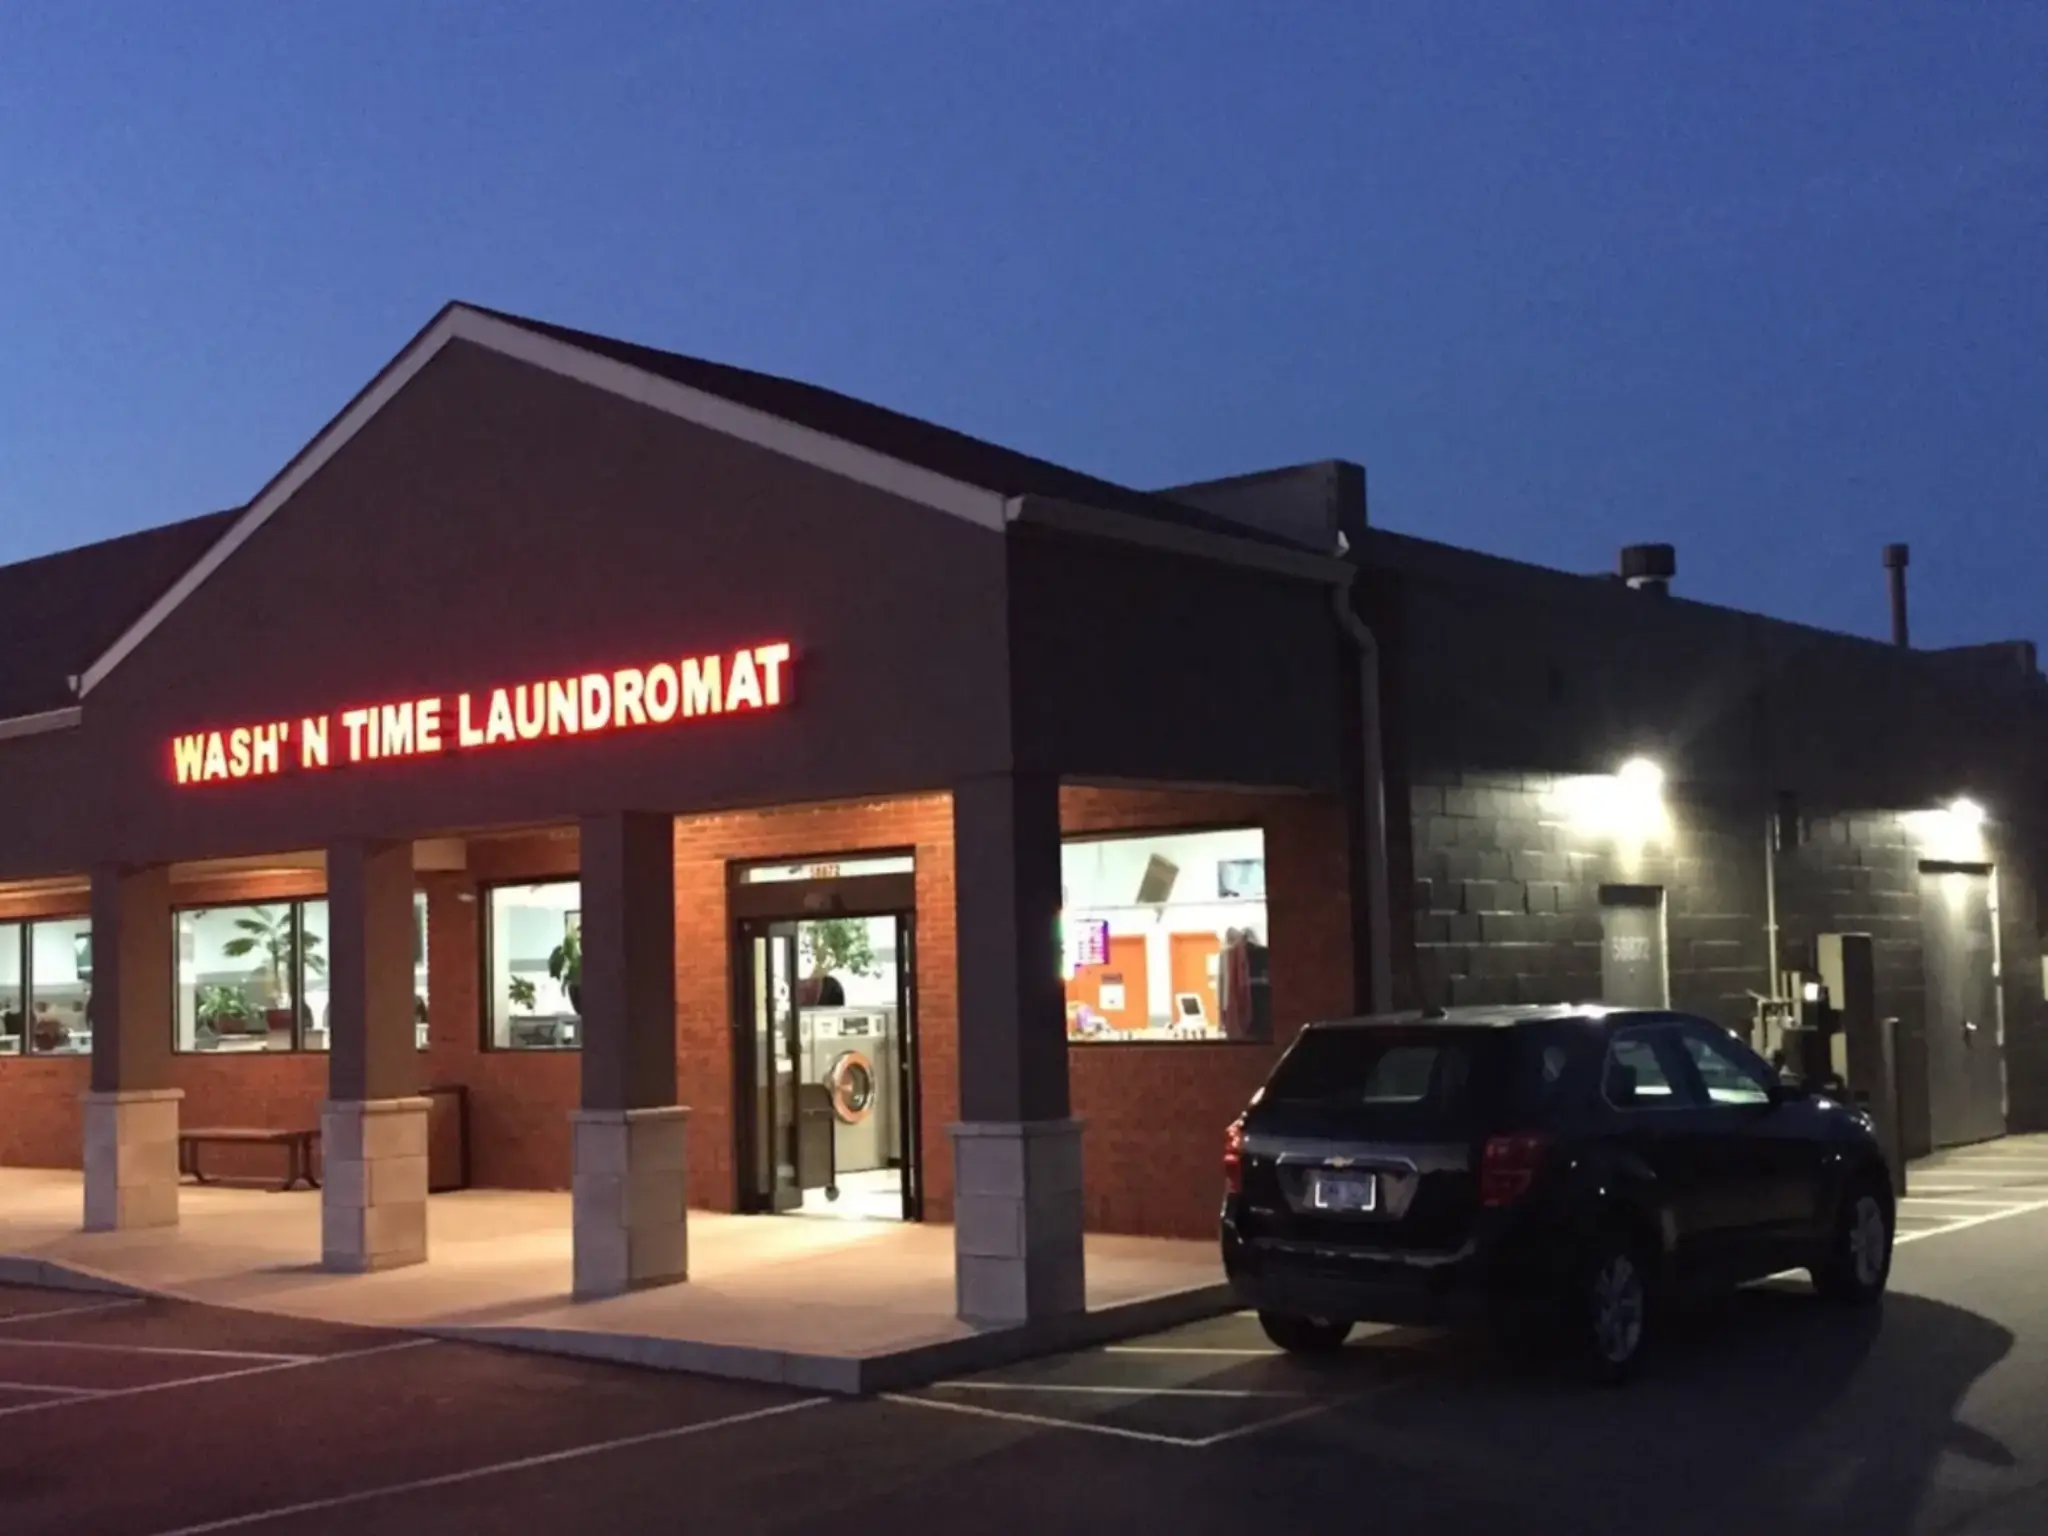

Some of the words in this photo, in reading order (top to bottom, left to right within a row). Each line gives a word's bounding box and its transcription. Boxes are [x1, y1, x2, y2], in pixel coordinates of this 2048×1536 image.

[174, 722, 289, 784] WASH'
[302, 716, 328, 768] N
[342, 698, 442, 761] TIME
[459, 643, 790, 747] LAUNDROMAT
